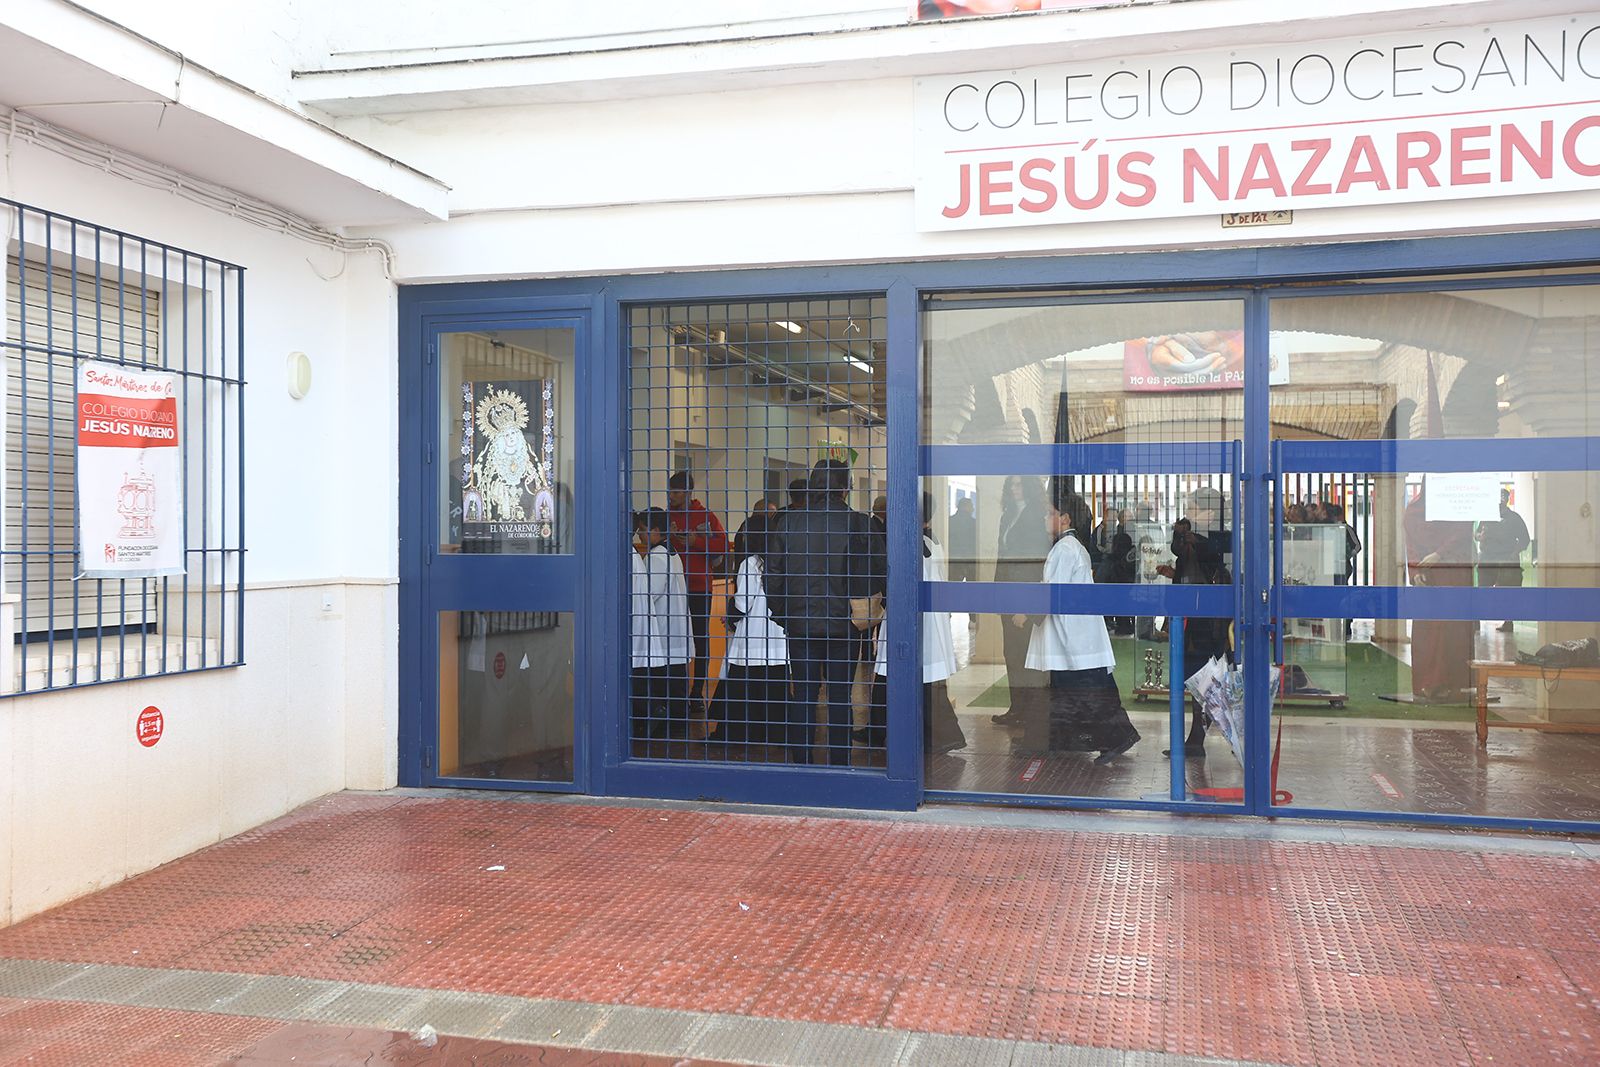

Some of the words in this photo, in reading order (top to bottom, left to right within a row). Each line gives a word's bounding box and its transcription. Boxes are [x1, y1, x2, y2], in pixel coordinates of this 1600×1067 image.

[944, 65, 1203, 132] COLEGIO
[942, 138, 1157, 218] JESÚS
[1183, 115, 1600, 203] NAZARENO
[1239, 215, 1250, 224] DE
[1163, 373, 1206, 386] posible
[1209, 372, 1221, 383] la
[82, 402, 138, 419] COLEGIO
[81, 419, 130, 435] JESÚS
[490, 524, 498, 533] EL
[499, 524, 536, 533] NAZARENO
